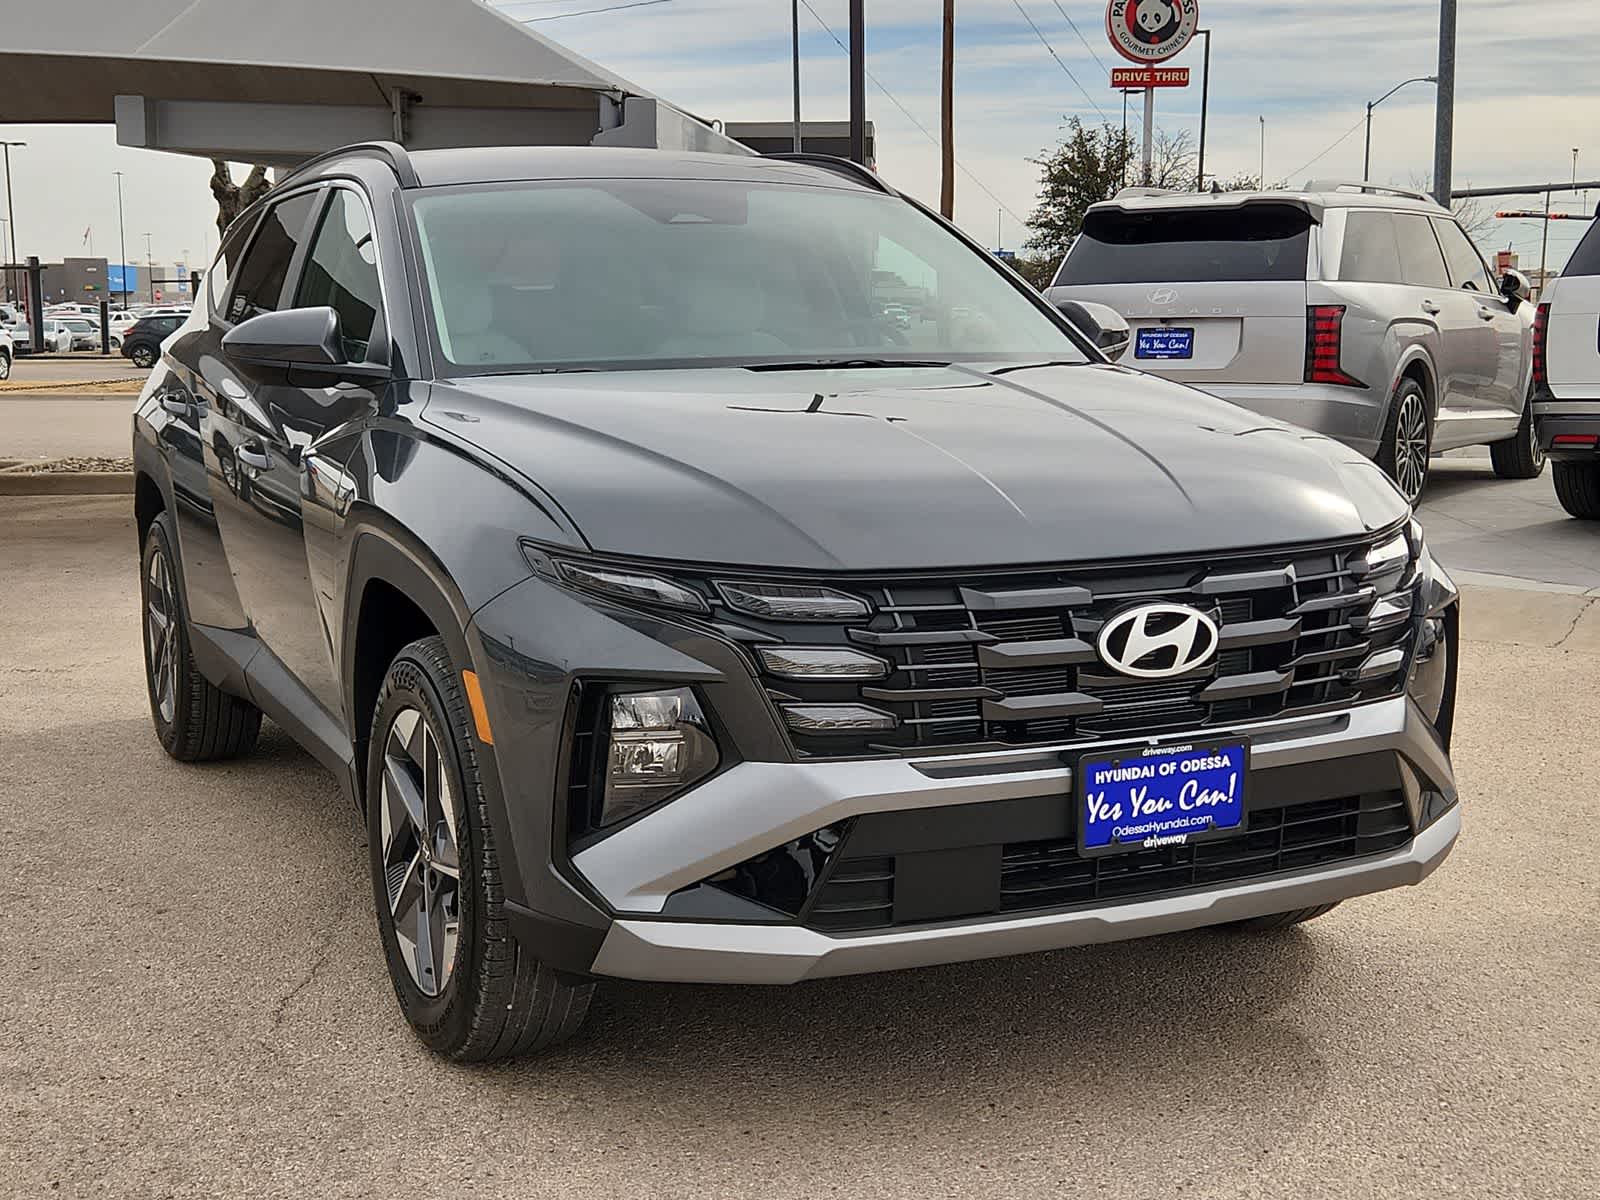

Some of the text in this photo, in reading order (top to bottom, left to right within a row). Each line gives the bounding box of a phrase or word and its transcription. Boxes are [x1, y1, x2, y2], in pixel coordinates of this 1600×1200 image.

[1119, 30, 1188, 55] GOURMET CHINESE
[1113, 71, 1188, 82] DRIVE THRU
[1139, 339, 1150, 349] Yes
[1142, 744, 1193, 757] driveway.com
[1095, 755, 1231, 784] HYUNDAI OF ODESSA
[1087, 772, 1237, 823] Yes You Can!
[1112, 815, 1213, 837] OdessaHyundai.com
[1143, 834, 1188, 848] driveway
